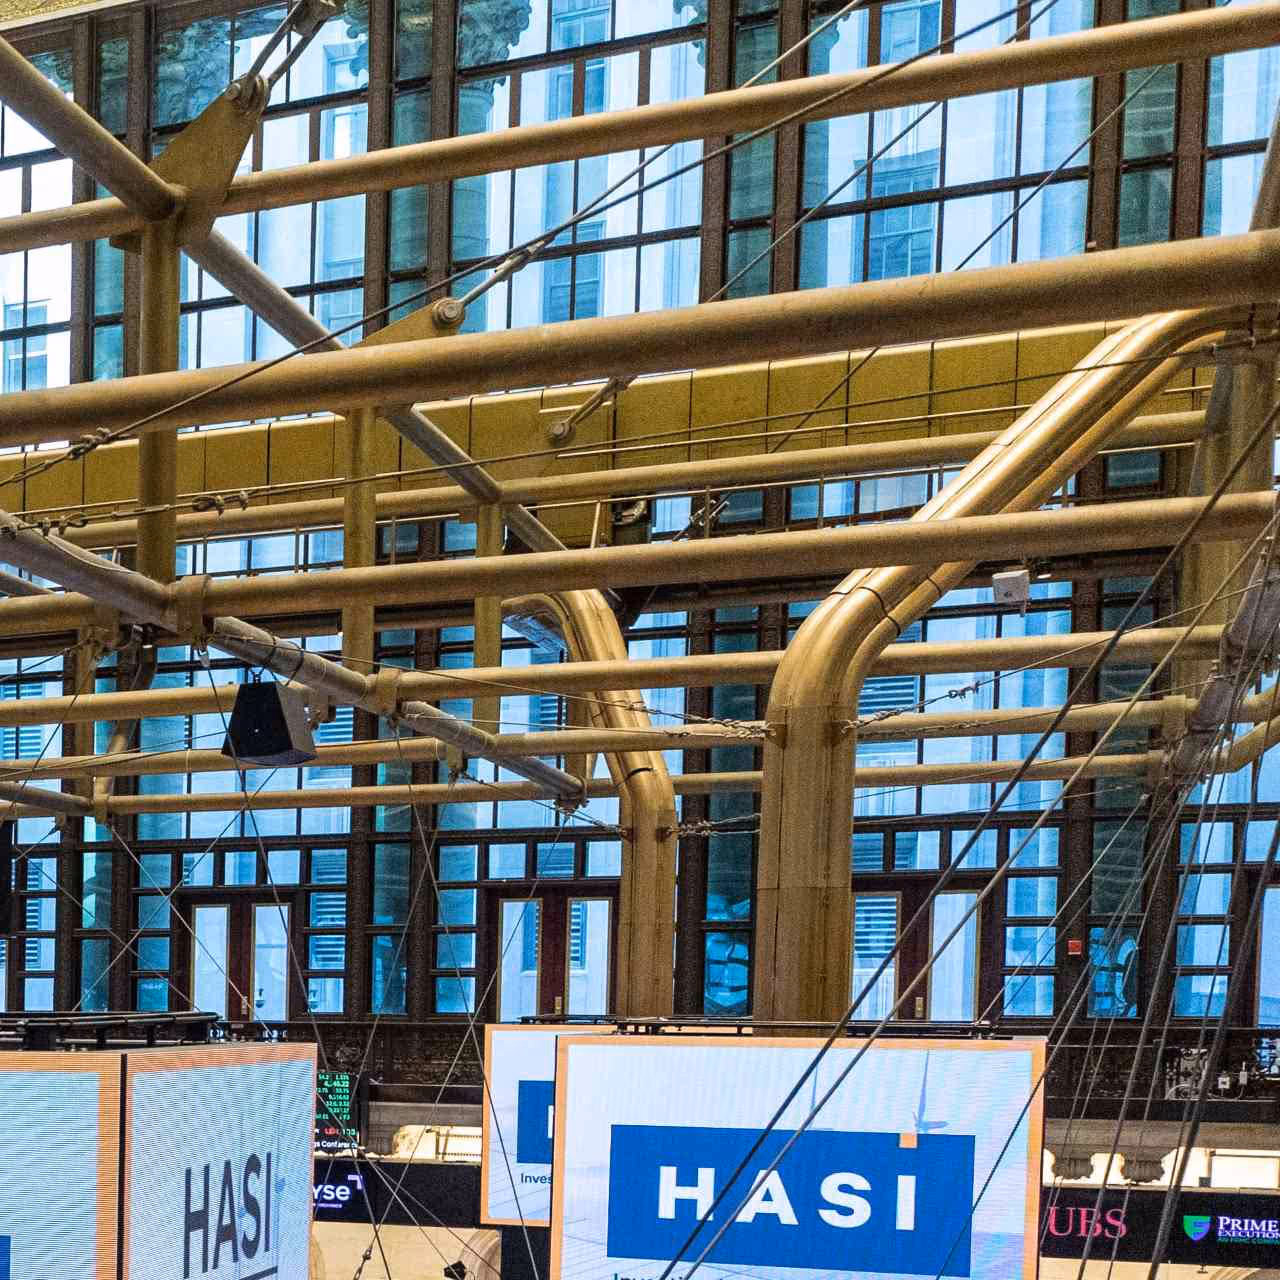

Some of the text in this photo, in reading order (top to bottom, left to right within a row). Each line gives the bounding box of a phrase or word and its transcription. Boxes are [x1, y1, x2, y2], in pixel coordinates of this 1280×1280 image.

[183, 1151, 272, 1280] HASI
[658, 1165, 917, 1231] HASI
[1048, 1205, 1128, 1239] UBS
[1218, 1216, 1279, 1232] PRIME
